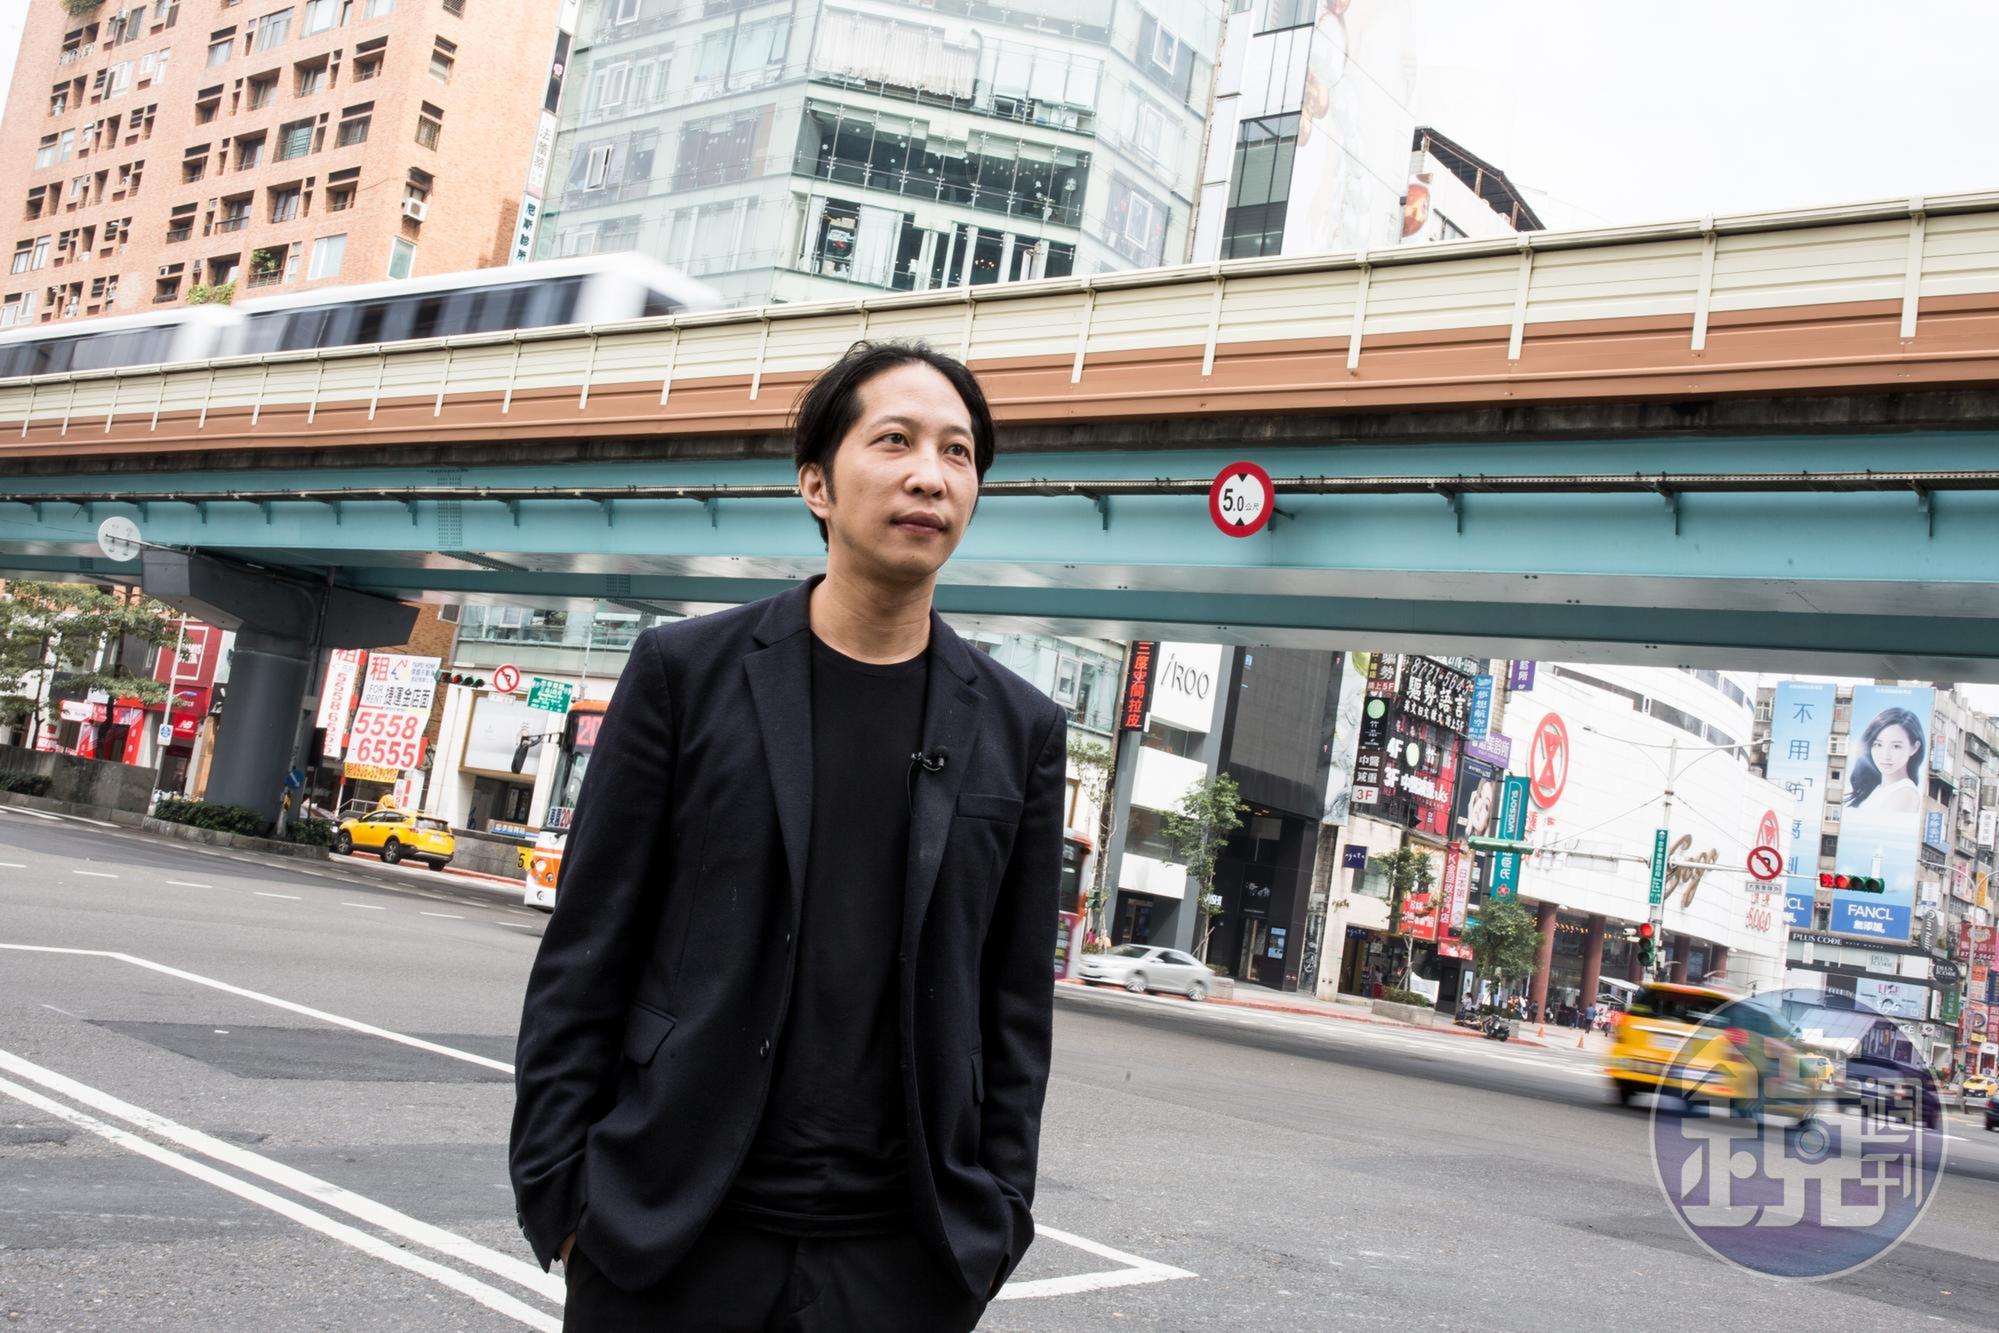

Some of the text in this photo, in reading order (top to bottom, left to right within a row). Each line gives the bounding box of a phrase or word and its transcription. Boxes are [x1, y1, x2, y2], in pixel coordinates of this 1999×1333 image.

[370, 656, 390, 682] 租
[1406, 676, 1466, 719] 驅勢語言
[355, 711, 418, 740] 5558
[1356, 789, 1374, 800] 3F
[1506, 790, 1519, 833] watsons
[1749, 884, 1781, 893] 大客車除外
[1848, 904, 1894, 921] FANCL
[1792, 932, 1817, 942] PLUS
[1817, 935, 1843, 945] CODE
